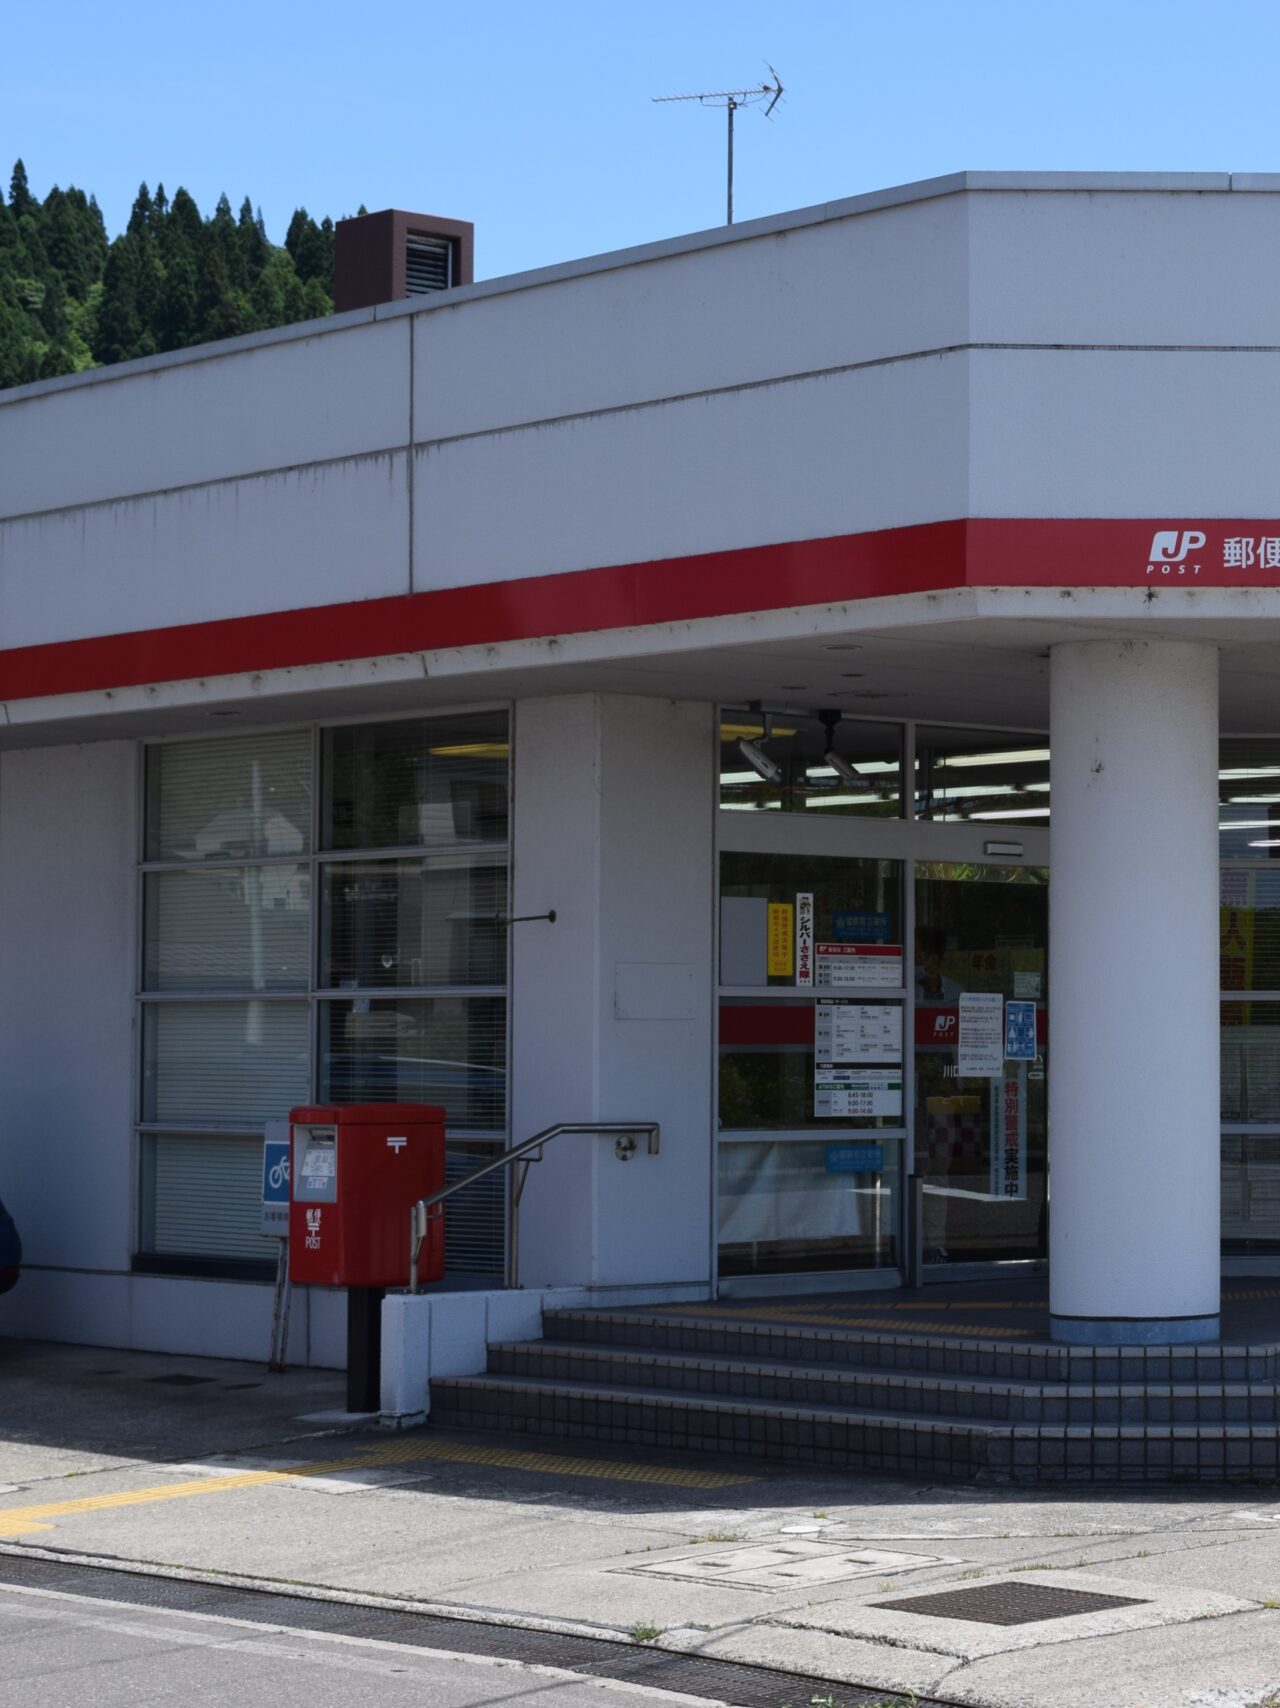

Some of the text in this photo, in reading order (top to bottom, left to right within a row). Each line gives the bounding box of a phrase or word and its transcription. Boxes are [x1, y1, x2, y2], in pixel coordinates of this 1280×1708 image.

[1149, 530, 1206, 562] JP
[1146, 564, 1201, 574] POST
[1004, 1081, 1019, 1197] 特別警戒実施中
[305, 1236, 321, 1249] POST
